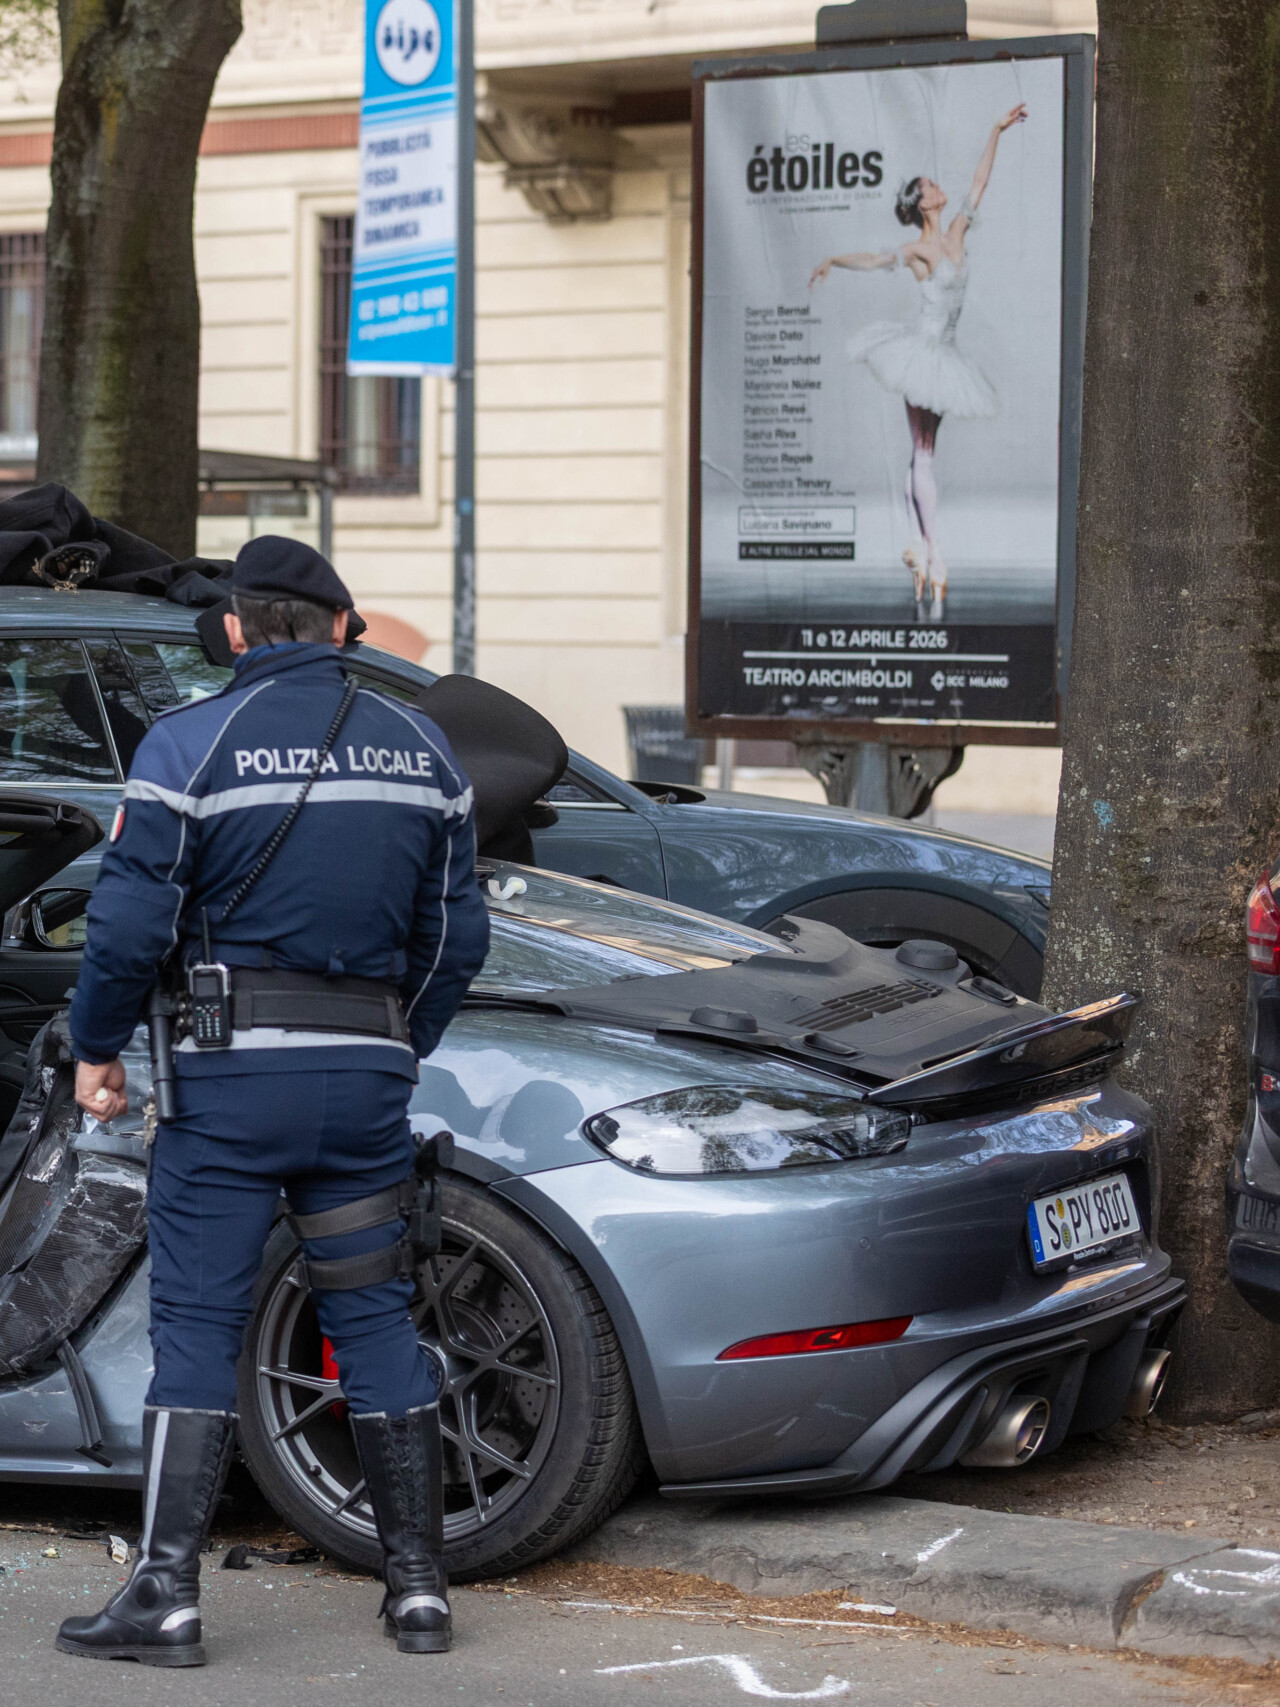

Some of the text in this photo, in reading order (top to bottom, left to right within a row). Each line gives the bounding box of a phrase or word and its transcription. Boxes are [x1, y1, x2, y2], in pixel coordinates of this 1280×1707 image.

[746, 143, 883, 194] étoiles
[744, 304, 810, 320] Sergio Bernal
[744, 330, 804, 342] Davide Dato
[744, 354, 822, 369] Hugo Marchand
[775, 429, 797, 439] Riva
[743, 453, 778, 464] Simone
[743, 479, 794, 489] Cassandra
[821, 545, 852, 556] MONDO
[801, 629, 948, 649] 11 e 12 APRILE 2026
[743, 667, 913, 688] TEATRO ARCIMBOLDI
[969, 676, 1009, 688] MILANO
[346, 745, 433, 777] LOCALE
[1045, 1181, 1131, 1251] S PY 800
[1034, 1239, 1041, 1253] D
